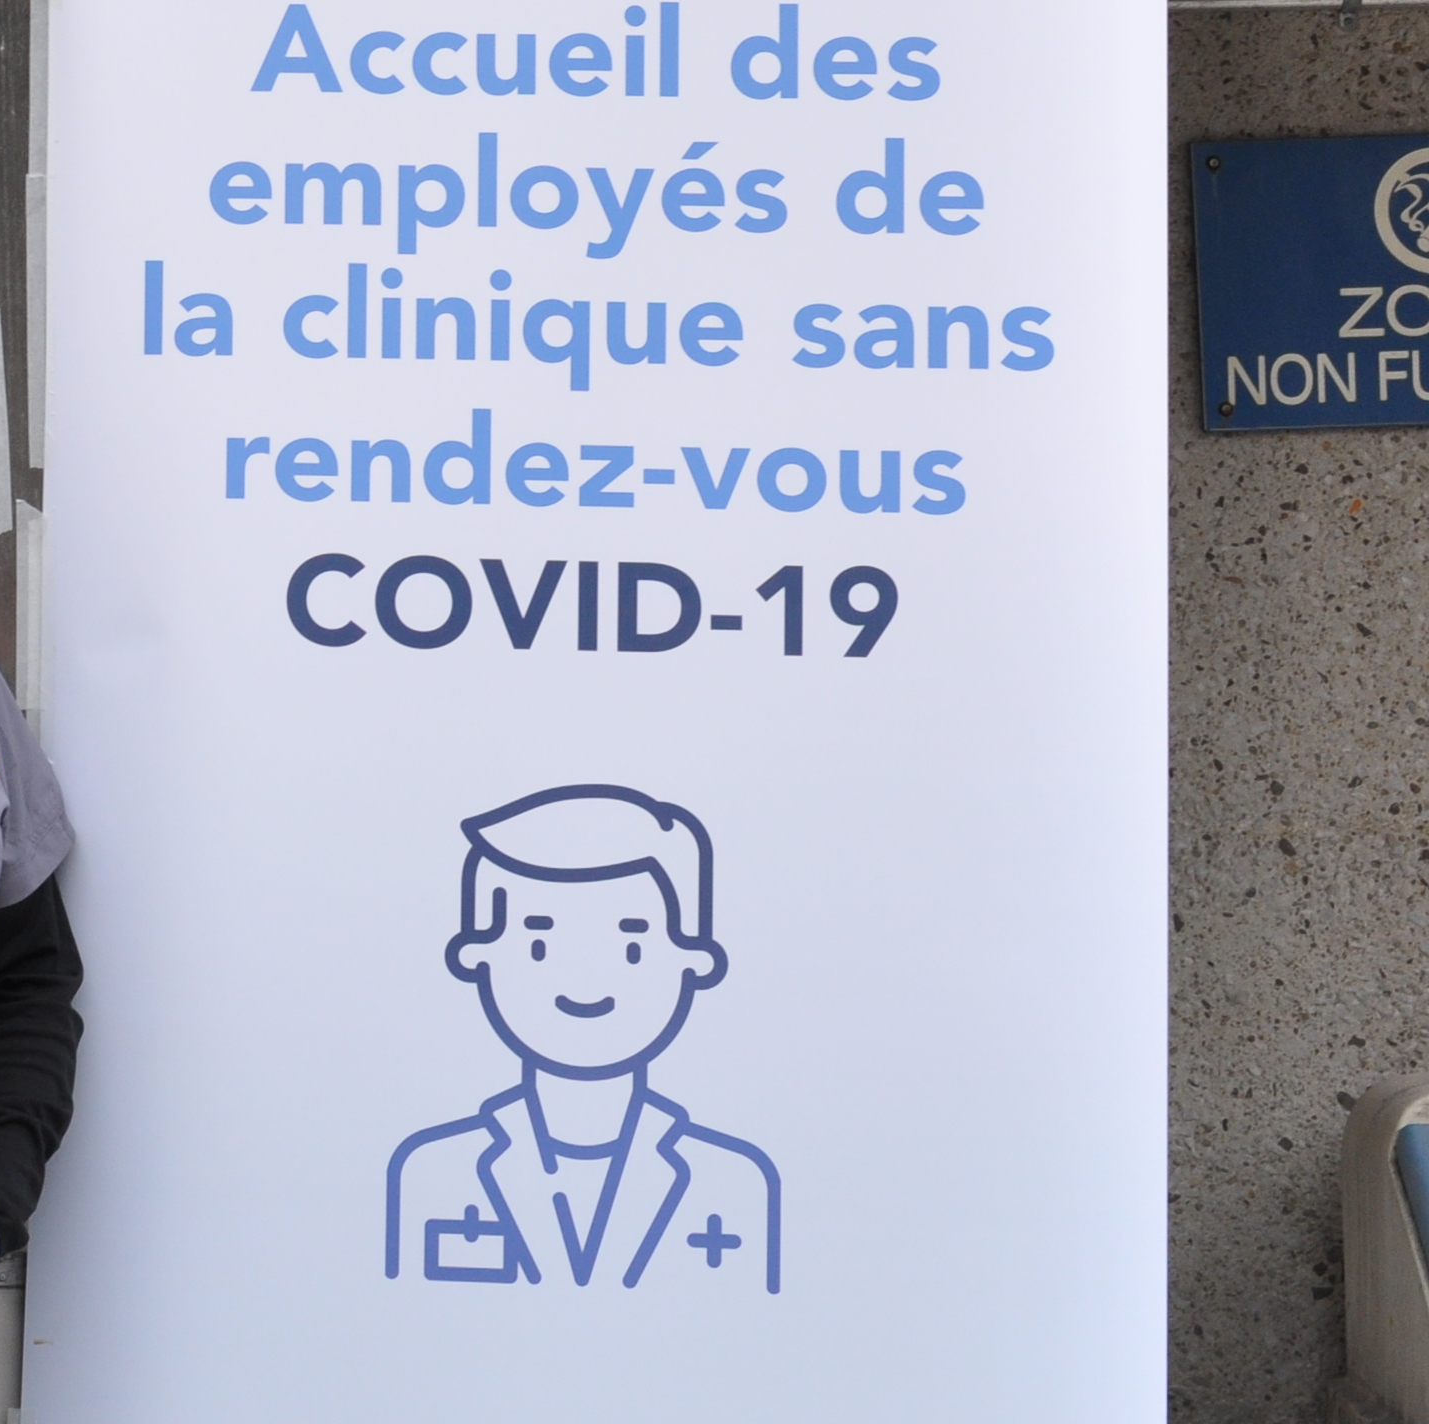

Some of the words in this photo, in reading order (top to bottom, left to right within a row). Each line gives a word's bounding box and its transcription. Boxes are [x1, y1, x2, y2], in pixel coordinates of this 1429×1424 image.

[250, 1, 682, 98] Accueil
[730, 2, 943, 102] des
[208, 131, 790, 260] employés
[835, 137, 987, 237] de
[143, 259, 236, 358] la
[282, 262, 745, 393] clinique
[792, 303, 1057, 373] sans
[1226, 351, 1357, 406] NON
[224, 407, 969, 517] rendez-vous
[286, 552, 900, 659] COVID-19
